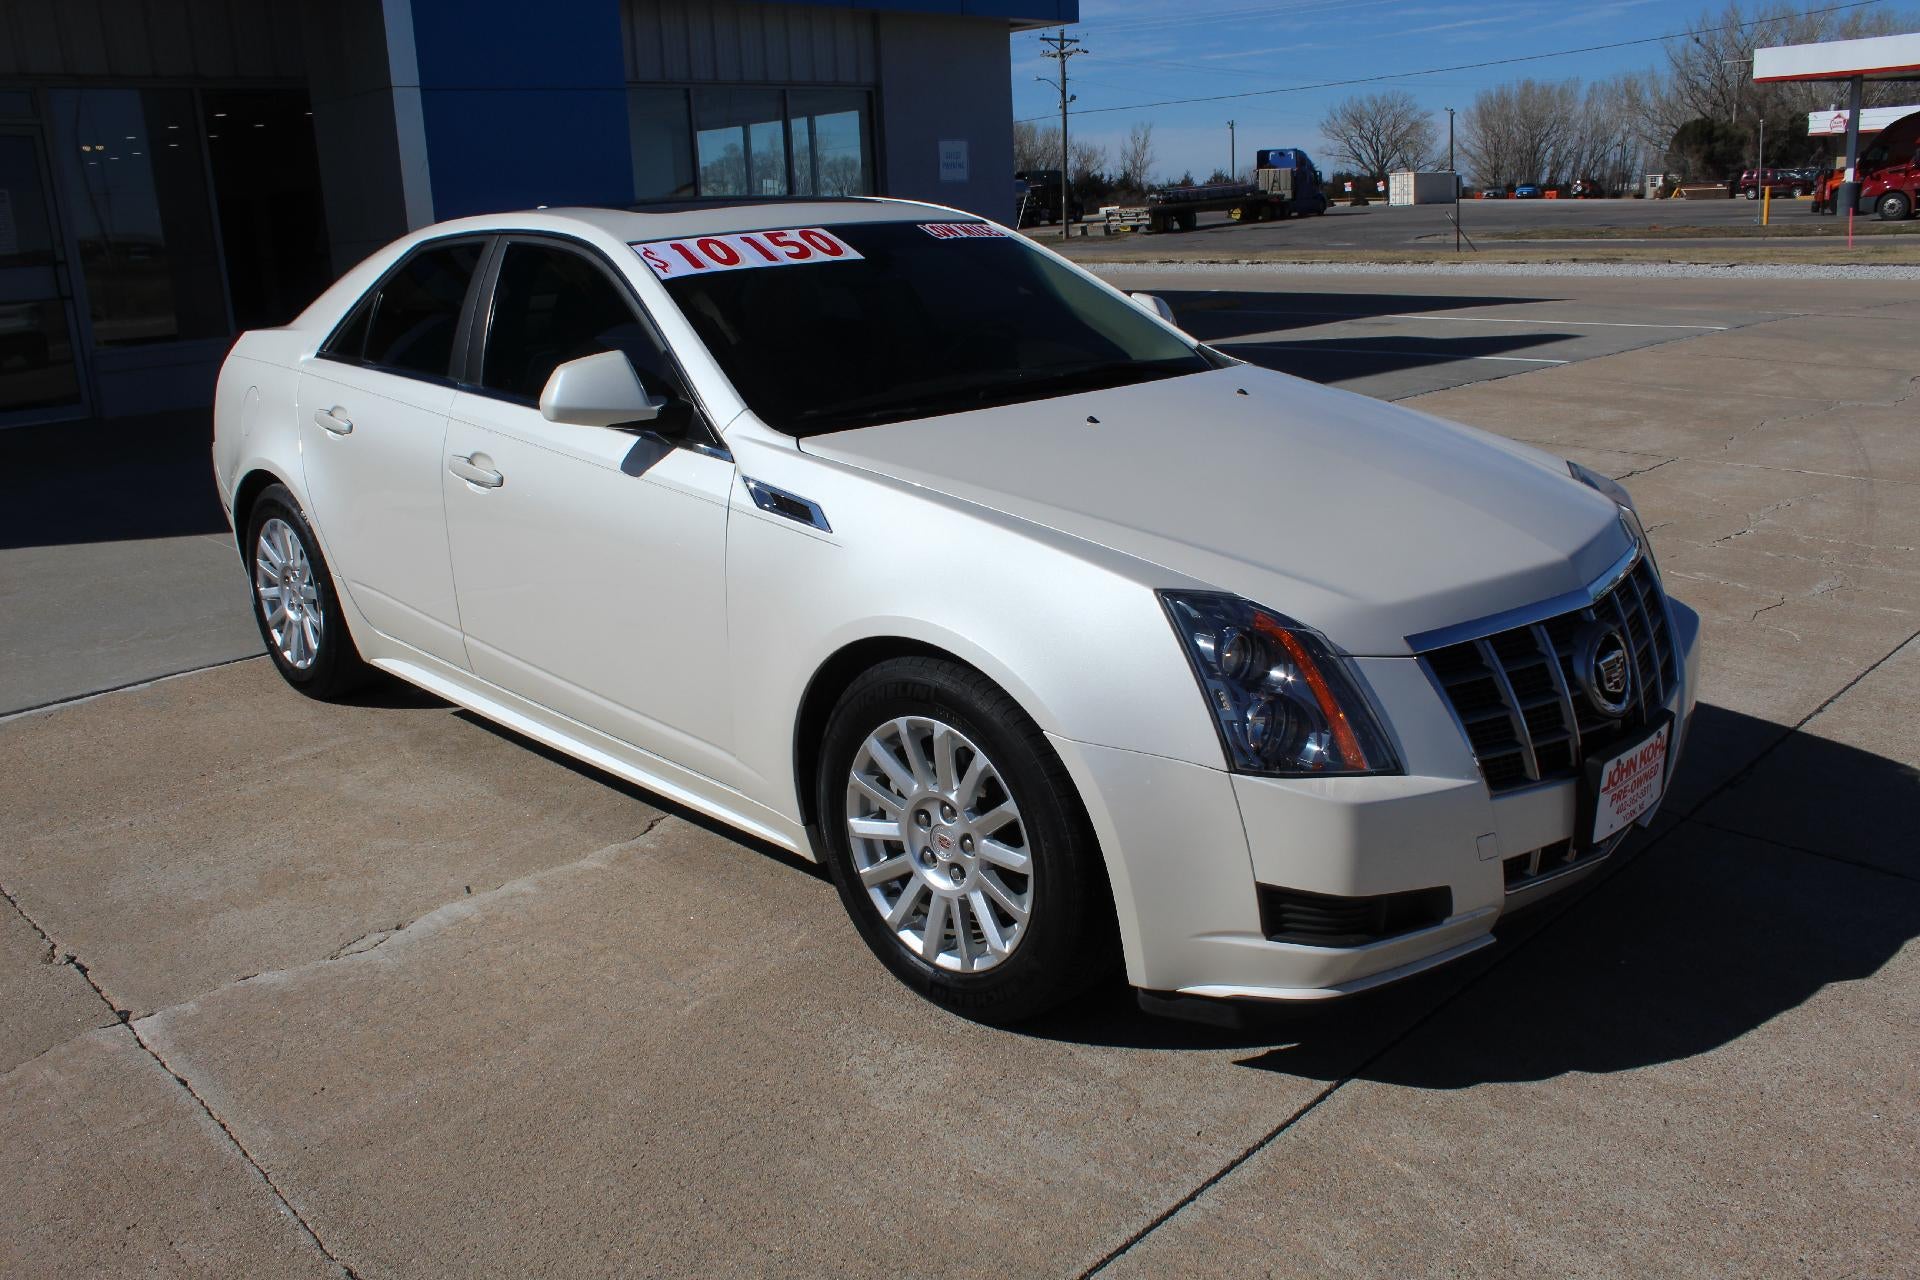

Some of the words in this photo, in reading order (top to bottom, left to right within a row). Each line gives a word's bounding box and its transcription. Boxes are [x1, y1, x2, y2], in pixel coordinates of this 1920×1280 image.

[1601, 753, 1638, 794] JOHN
[1639, 735, 1665, 767] KOHL
[1609, 763, 1659, 808] PRE-OWNED
